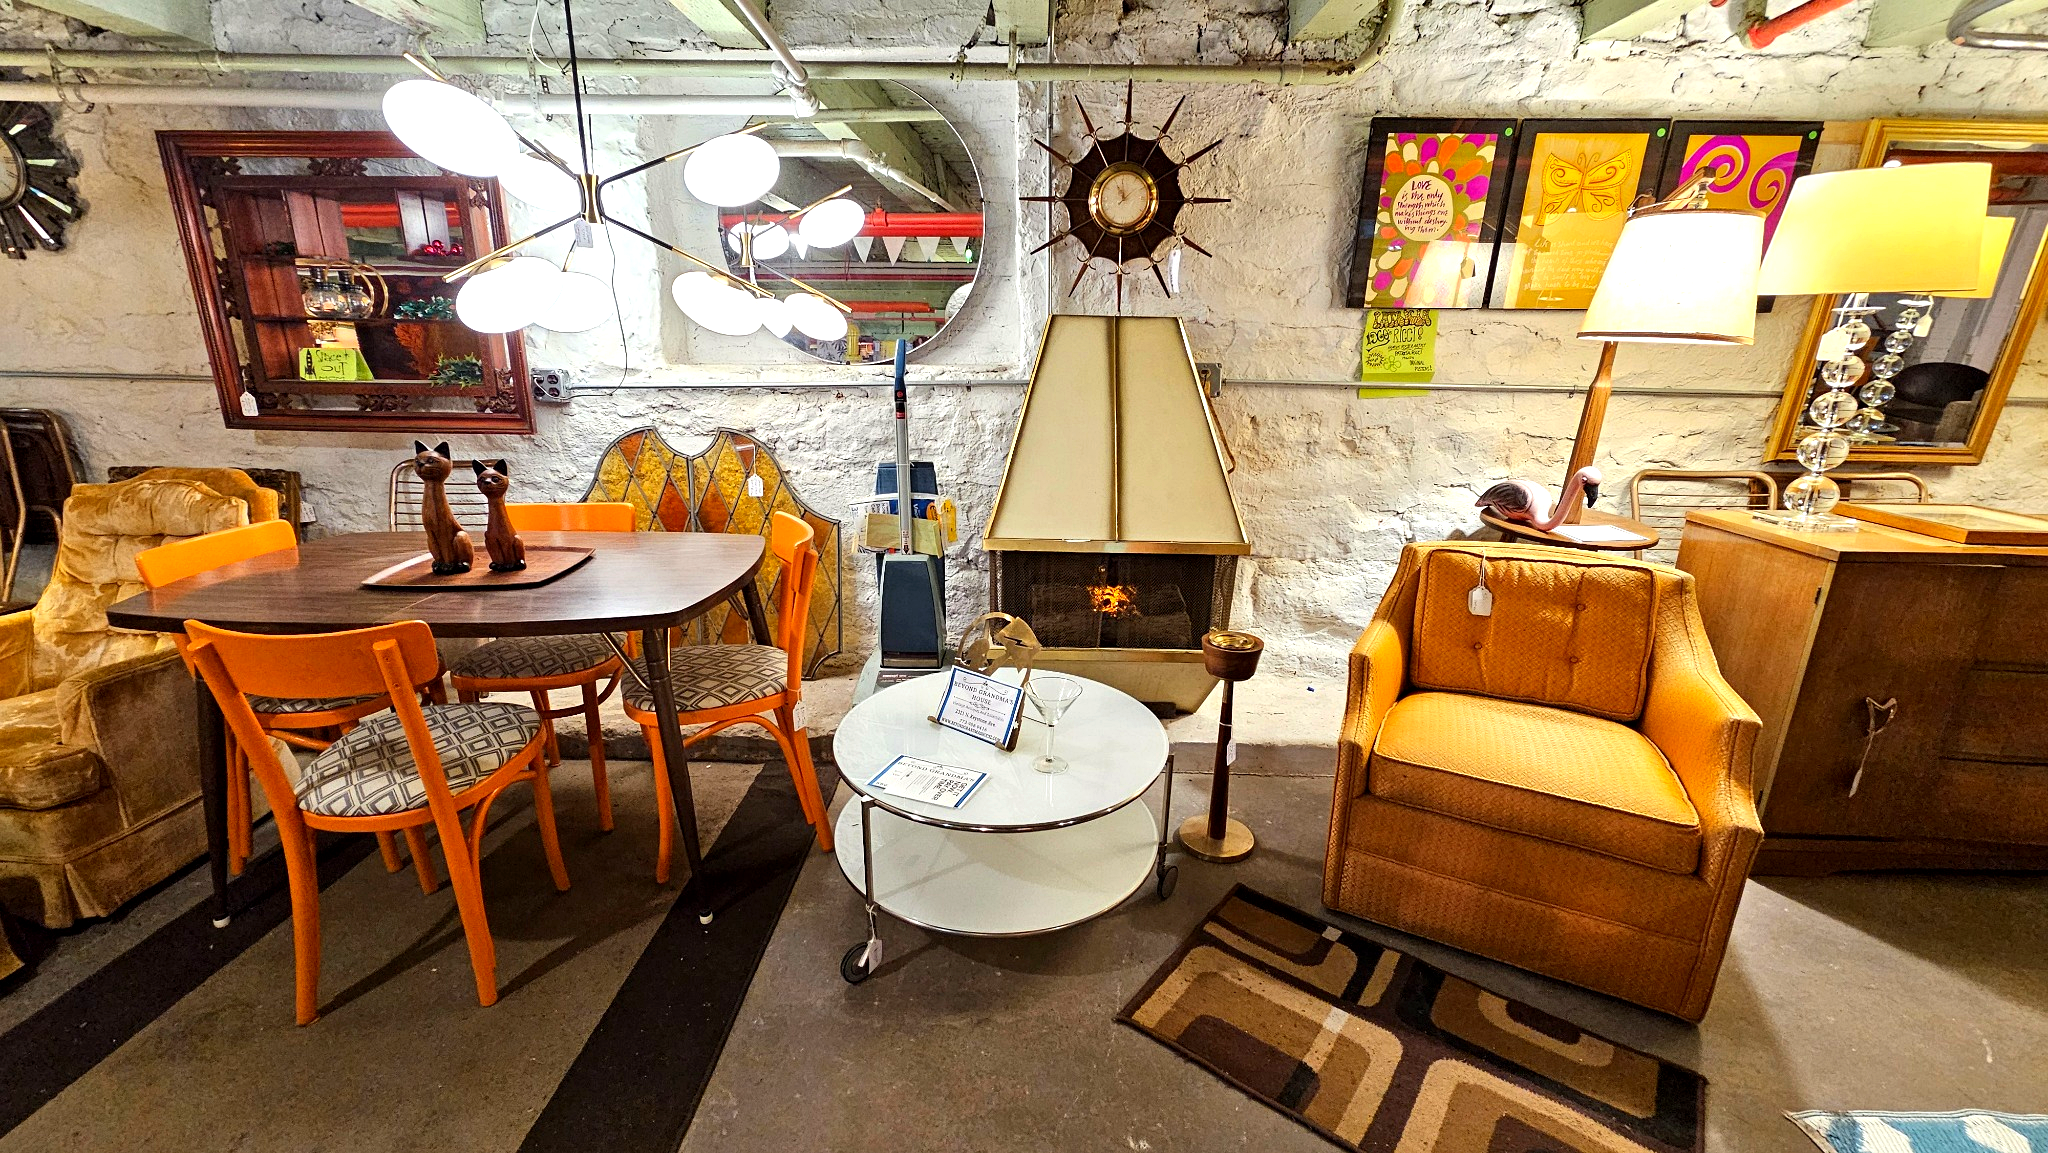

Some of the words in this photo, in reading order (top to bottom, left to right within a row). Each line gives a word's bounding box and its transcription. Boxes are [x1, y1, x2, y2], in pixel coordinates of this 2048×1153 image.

[1411, 180, 1432, 190] LOVE
[1402, 190, 1408, 202] is
[1411, 191, 1424, 201] the
[1427, 189, 1443, 202] only
[321, 361, 348, 375] OUT
[954, 680, 978, 693] BEYOND
[978, 689, 1014, 706] GRANDMA'S
[971, 694, 991, 706] HOUSE
[898, 761, 928, 771] BEYOND
